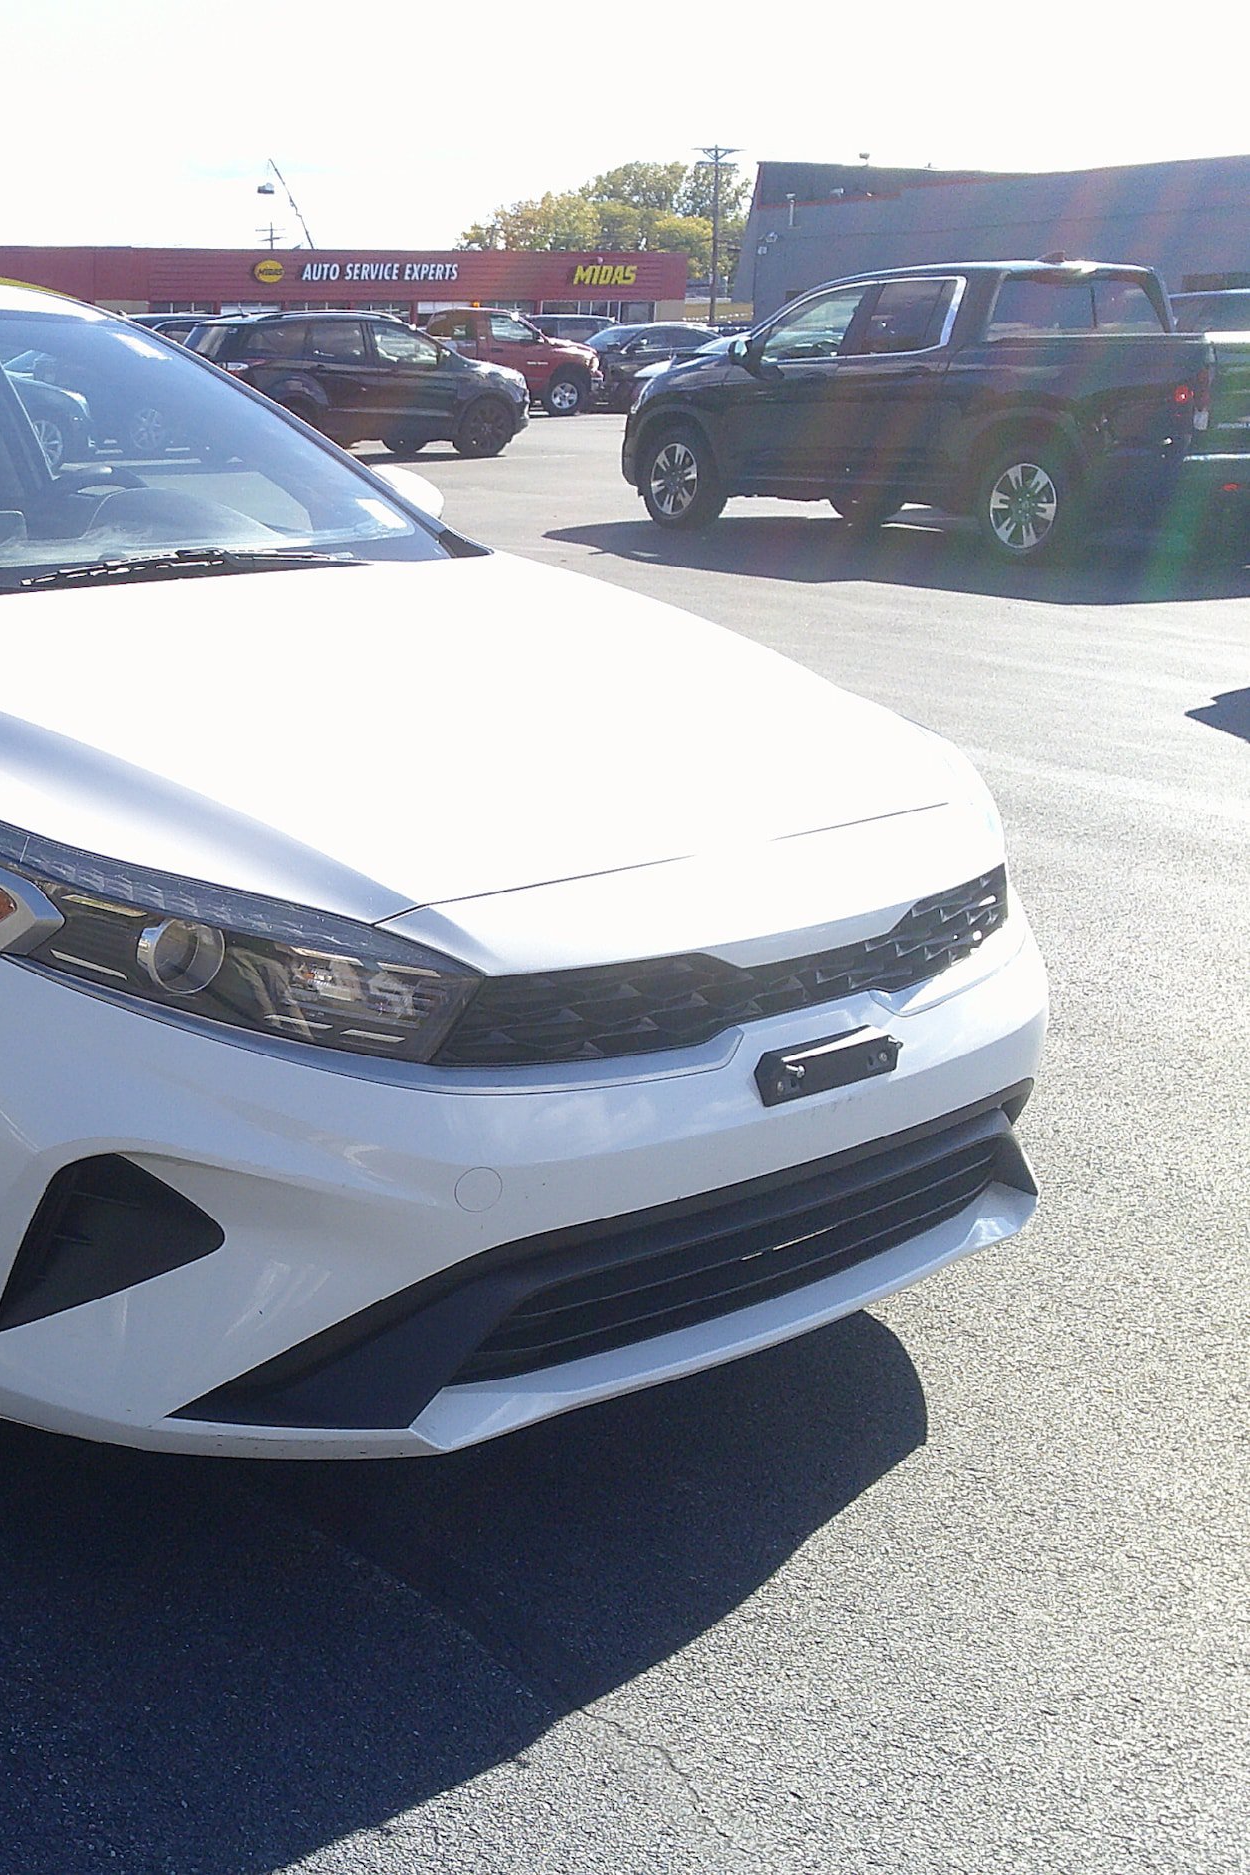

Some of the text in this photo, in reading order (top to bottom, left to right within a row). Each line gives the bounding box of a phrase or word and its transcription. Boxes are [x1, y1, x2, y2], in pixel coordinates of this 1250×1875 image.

[301, 263, 458, 281] AUTO SERVICE EXPERTS
[572, 264, 638, 286] MIDAS
